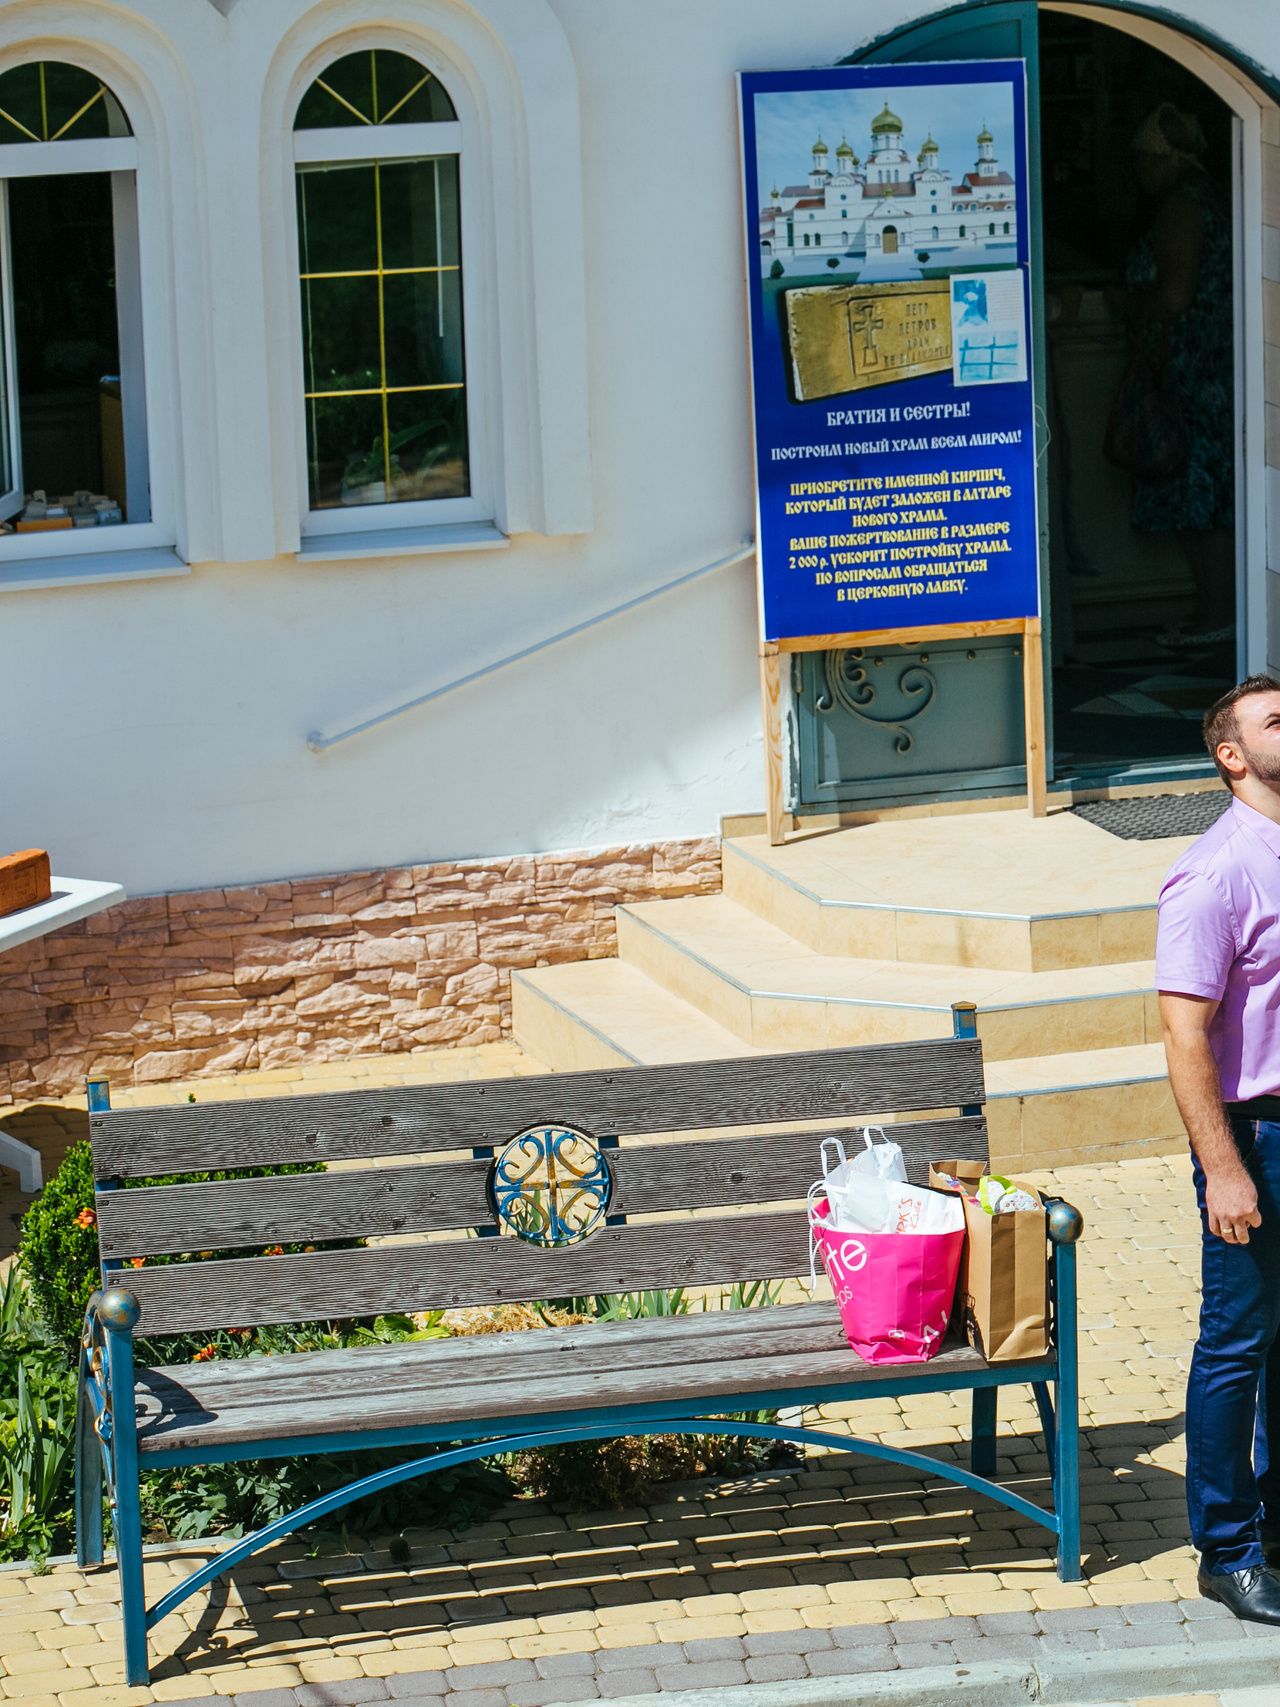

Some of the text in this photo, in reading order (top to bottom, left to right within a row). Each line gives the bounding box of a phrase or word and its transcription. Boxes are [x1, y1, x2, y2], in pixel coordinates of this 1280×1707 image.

[827, 401, 970, 426] БРАТИЯ И СЕСТРЫ!
[772, 430, 1021, 460] ПОСТРОИМ НОВЫЙ ХРАМ ВСЕМ МИРОМ!
[790, 468, 1005, 495] ПРИОБРЕТИТЕ ИМЕННОЙ КИРПИЧ,
[785, 486, 1011, 514] КОТОРЫЙ БУДЕТ ЗАЛОЖЕН В АЛТАРЕ
[853, 509, 947, 527] НОВОГО ХРАМА.
[789, 522, 1010, 550] ВАШЕ ПОЖЕРТВОВАНИЕ В РАЗМЕРЕ
[831, 549, 888, 567] УСКОРИТ
[890, 542, 963, 560] ПОСТРОЙКУ
[965, 539, 1011, 553] ХРАМА.
[816, 559, 987, 585] ПО ВОПРОСАМ ОБРАЩАТЬСЯ
[837, 579, 968, 602] В ЦЕРКОВНУЮ ЛАВКУ.
